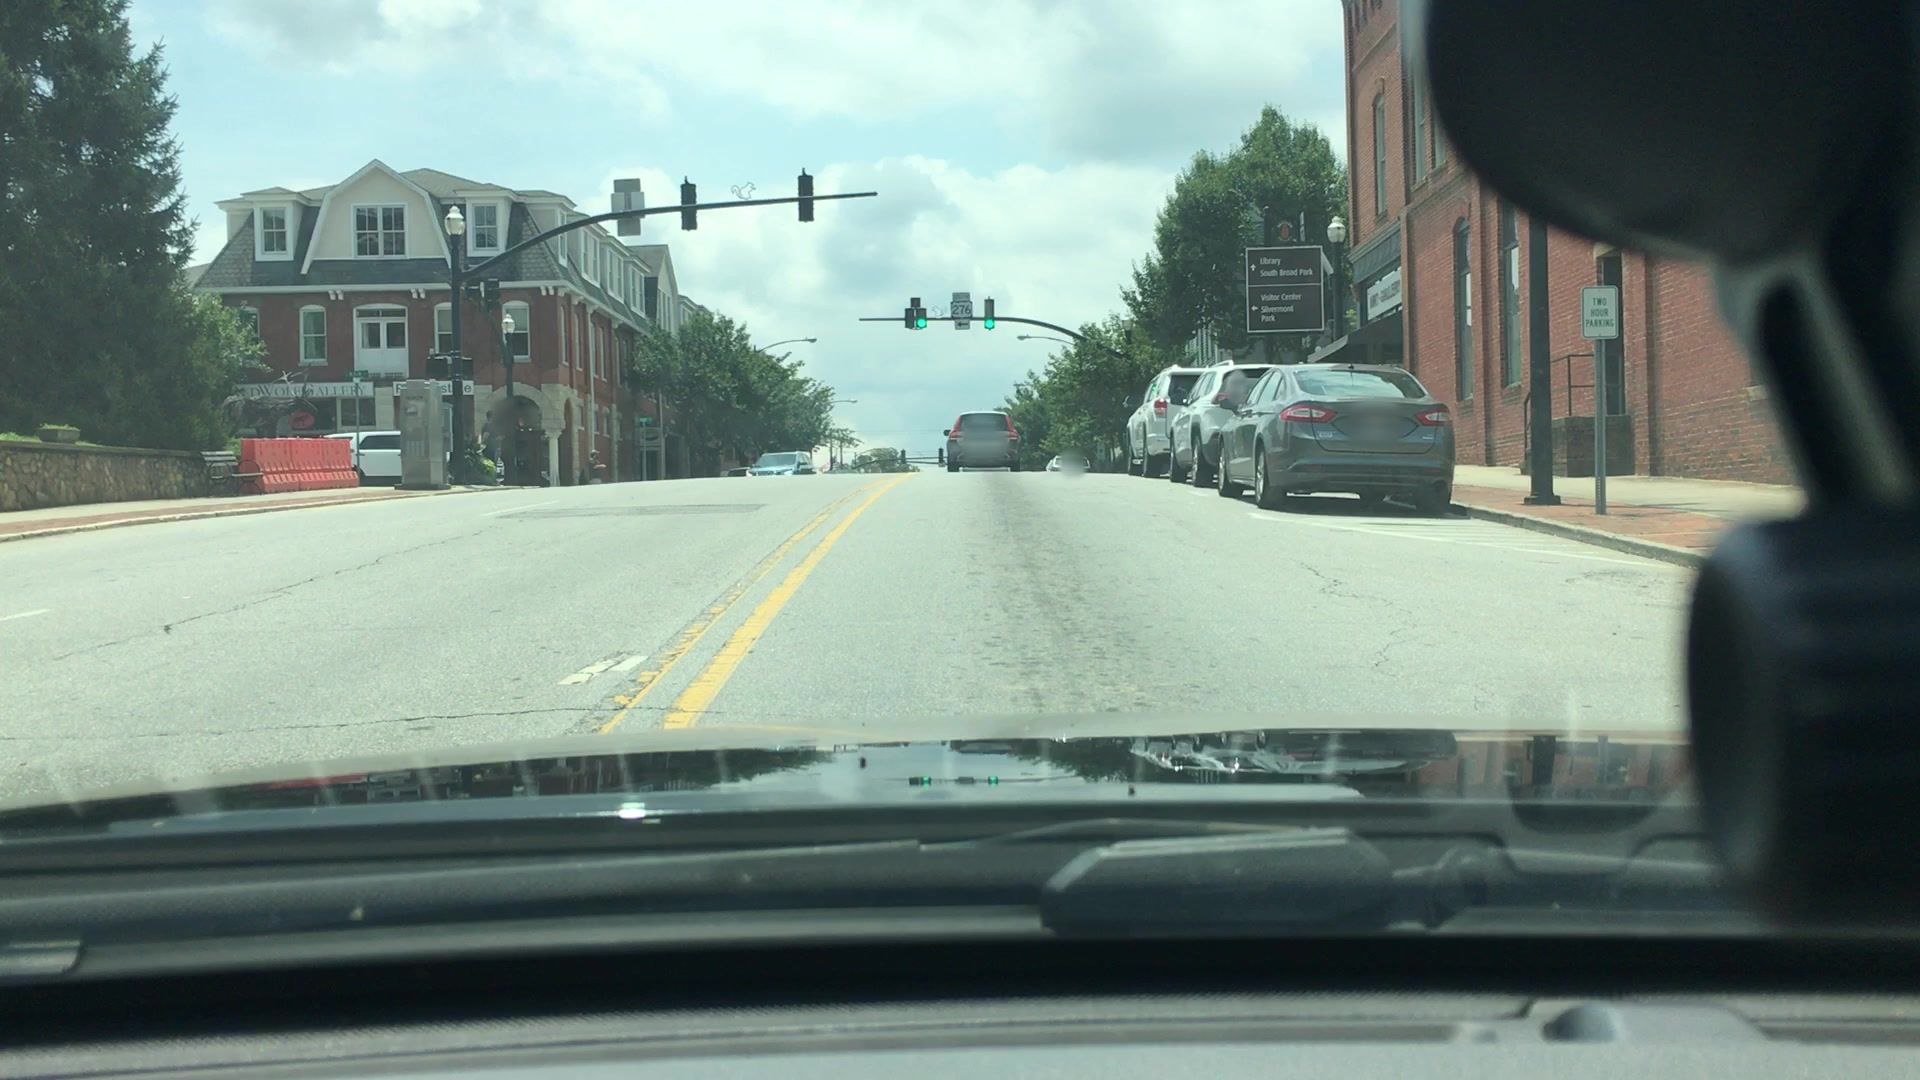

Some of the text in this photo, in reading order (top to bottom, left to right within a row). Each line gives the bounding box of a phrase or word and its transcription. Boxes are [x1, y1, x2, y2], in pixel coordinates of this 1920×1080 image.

[1260, 257, 1281, 266] Library
[1260, 269, 1278, 277] South
[1299, 268, 1313, 276] Park
[1261, 293, 1280, 301] Visitor
[1592, 297, 1607, 306] TWO
[952, 304, 970, 315] 276
[1590, 308, 1609, 317] HOUR
[1585, 319, 1615, 328] PARKING
